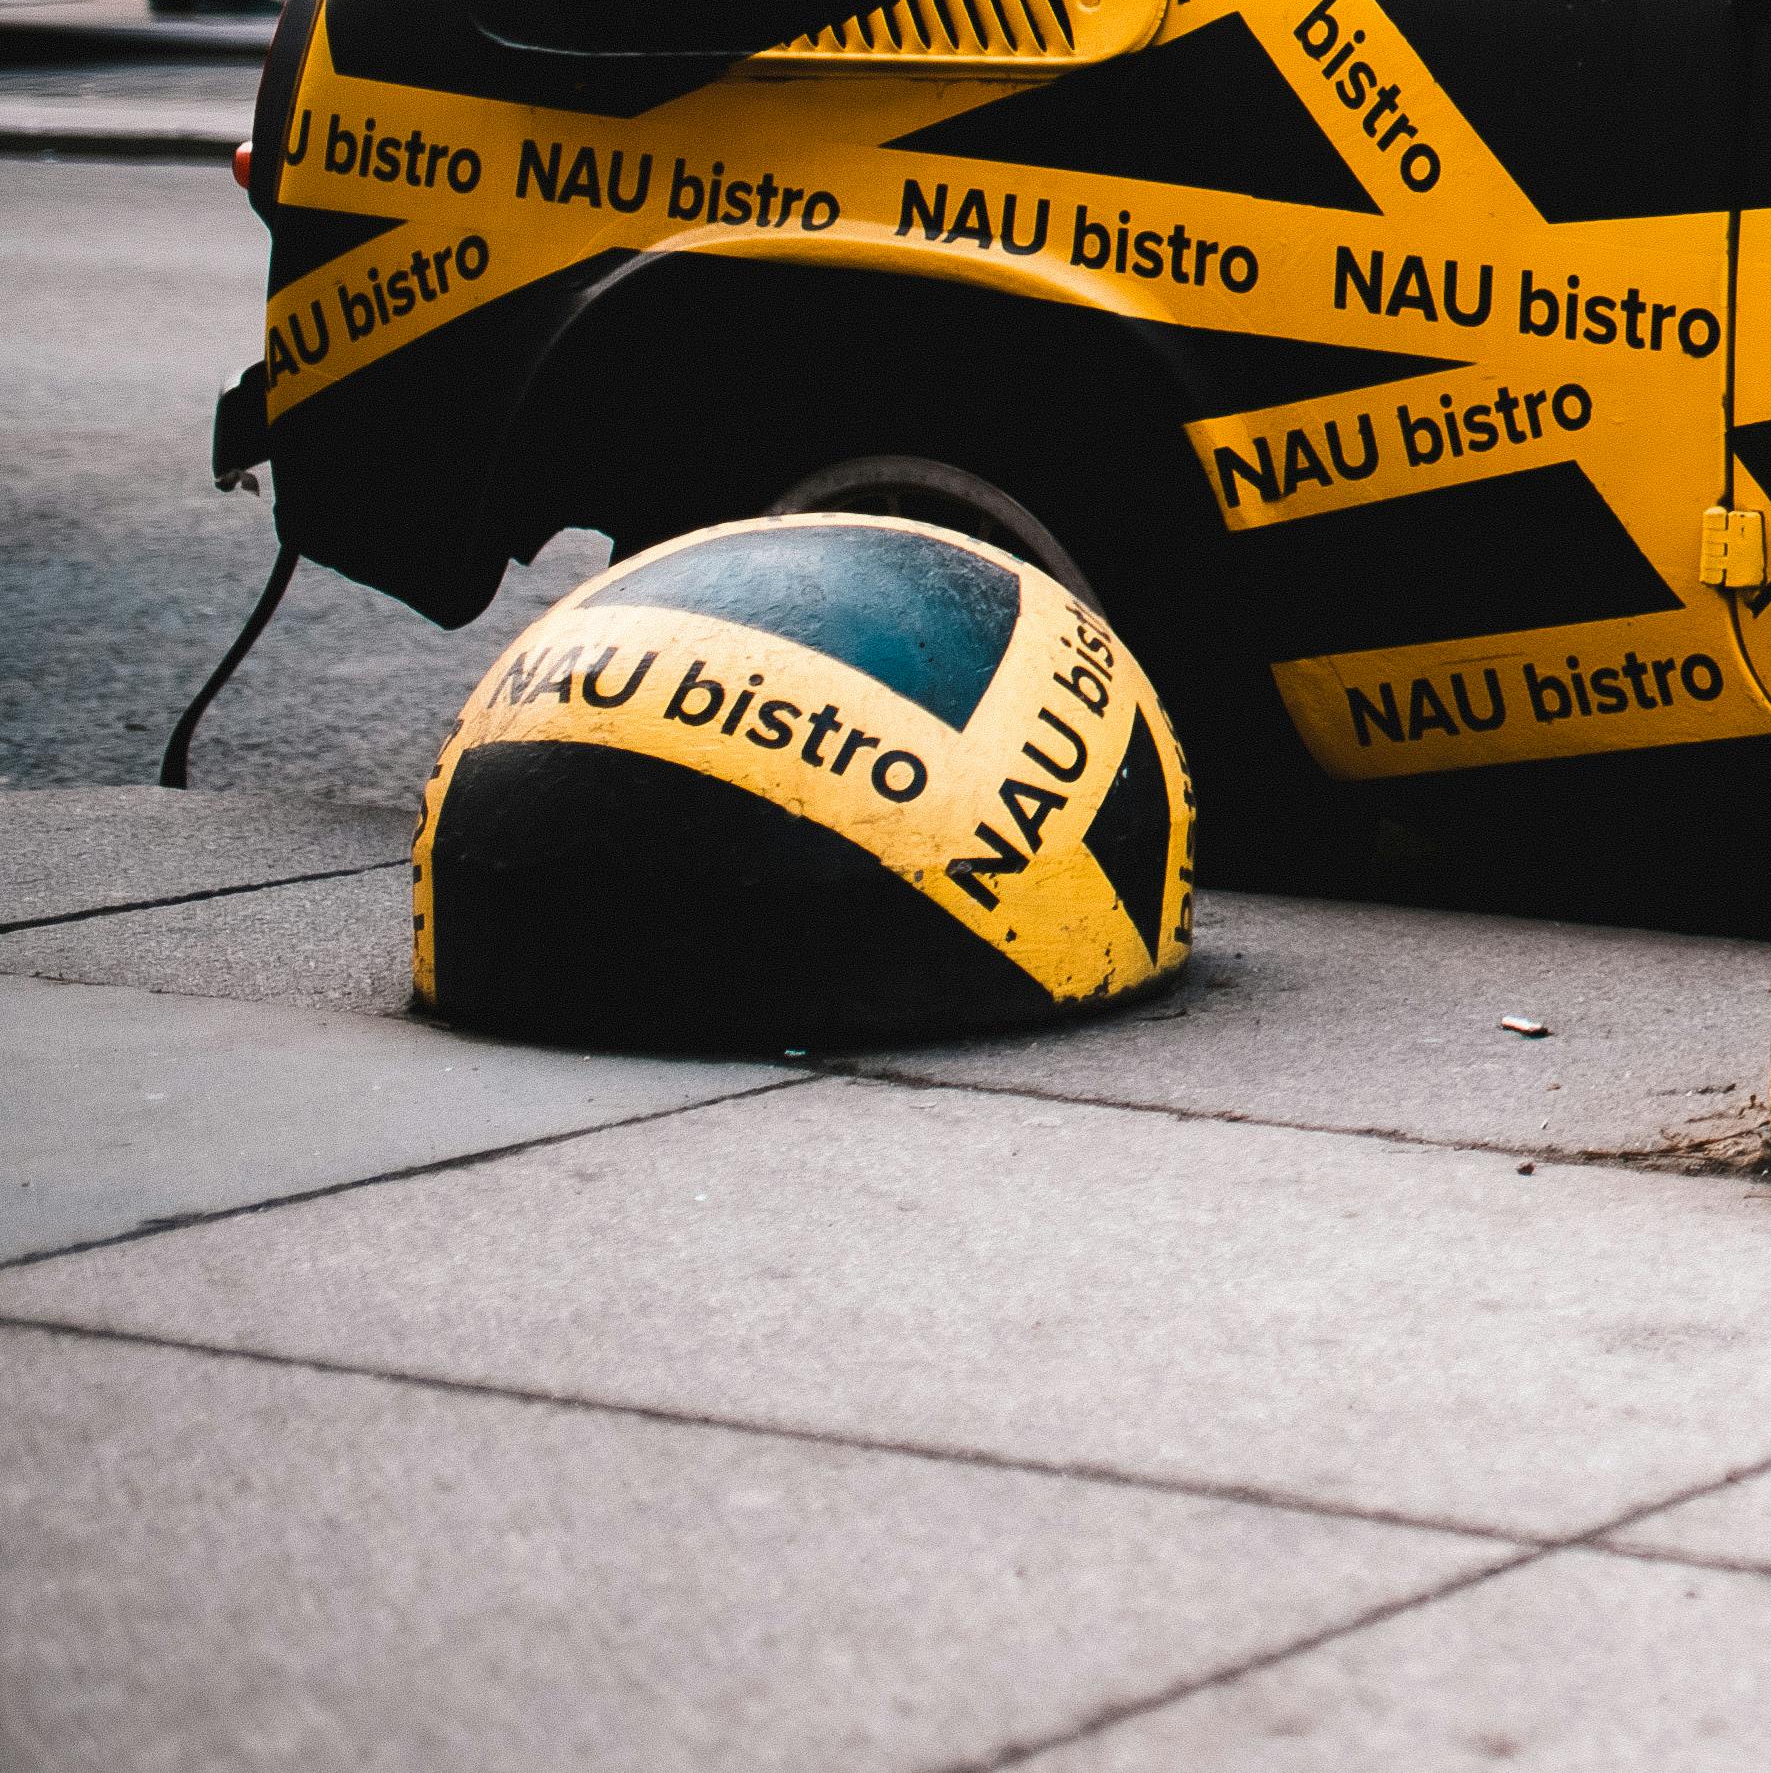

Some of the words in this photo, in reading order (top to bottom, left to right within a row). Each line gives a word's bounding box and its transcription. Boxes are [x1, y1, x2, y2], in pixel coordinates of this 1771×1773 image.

[325, 114, 481, 193] bistro
[516, 140, 651, 213] NAU
[669, 164, 840, 231] bistro
[898, 178, 1050, 254] NAU
[1070, 206, 1259, 293] bistro
[1332, 246, 1495, 328] NAU
[1519, 270, 1721, 359] bistro
[338, 235, 489, 343] bistro
[1214, 413, 1379, 508] NAU
[1400, 383, 1593, 468] bistro
[488, 646, 658, 709] NAU
[665, 660, 928, 805] bistro
[1346, 668, 1507, 747] NAU
[1523, 652, 1724, 724] bistro
[946, 707, 1087, 912] NAU
